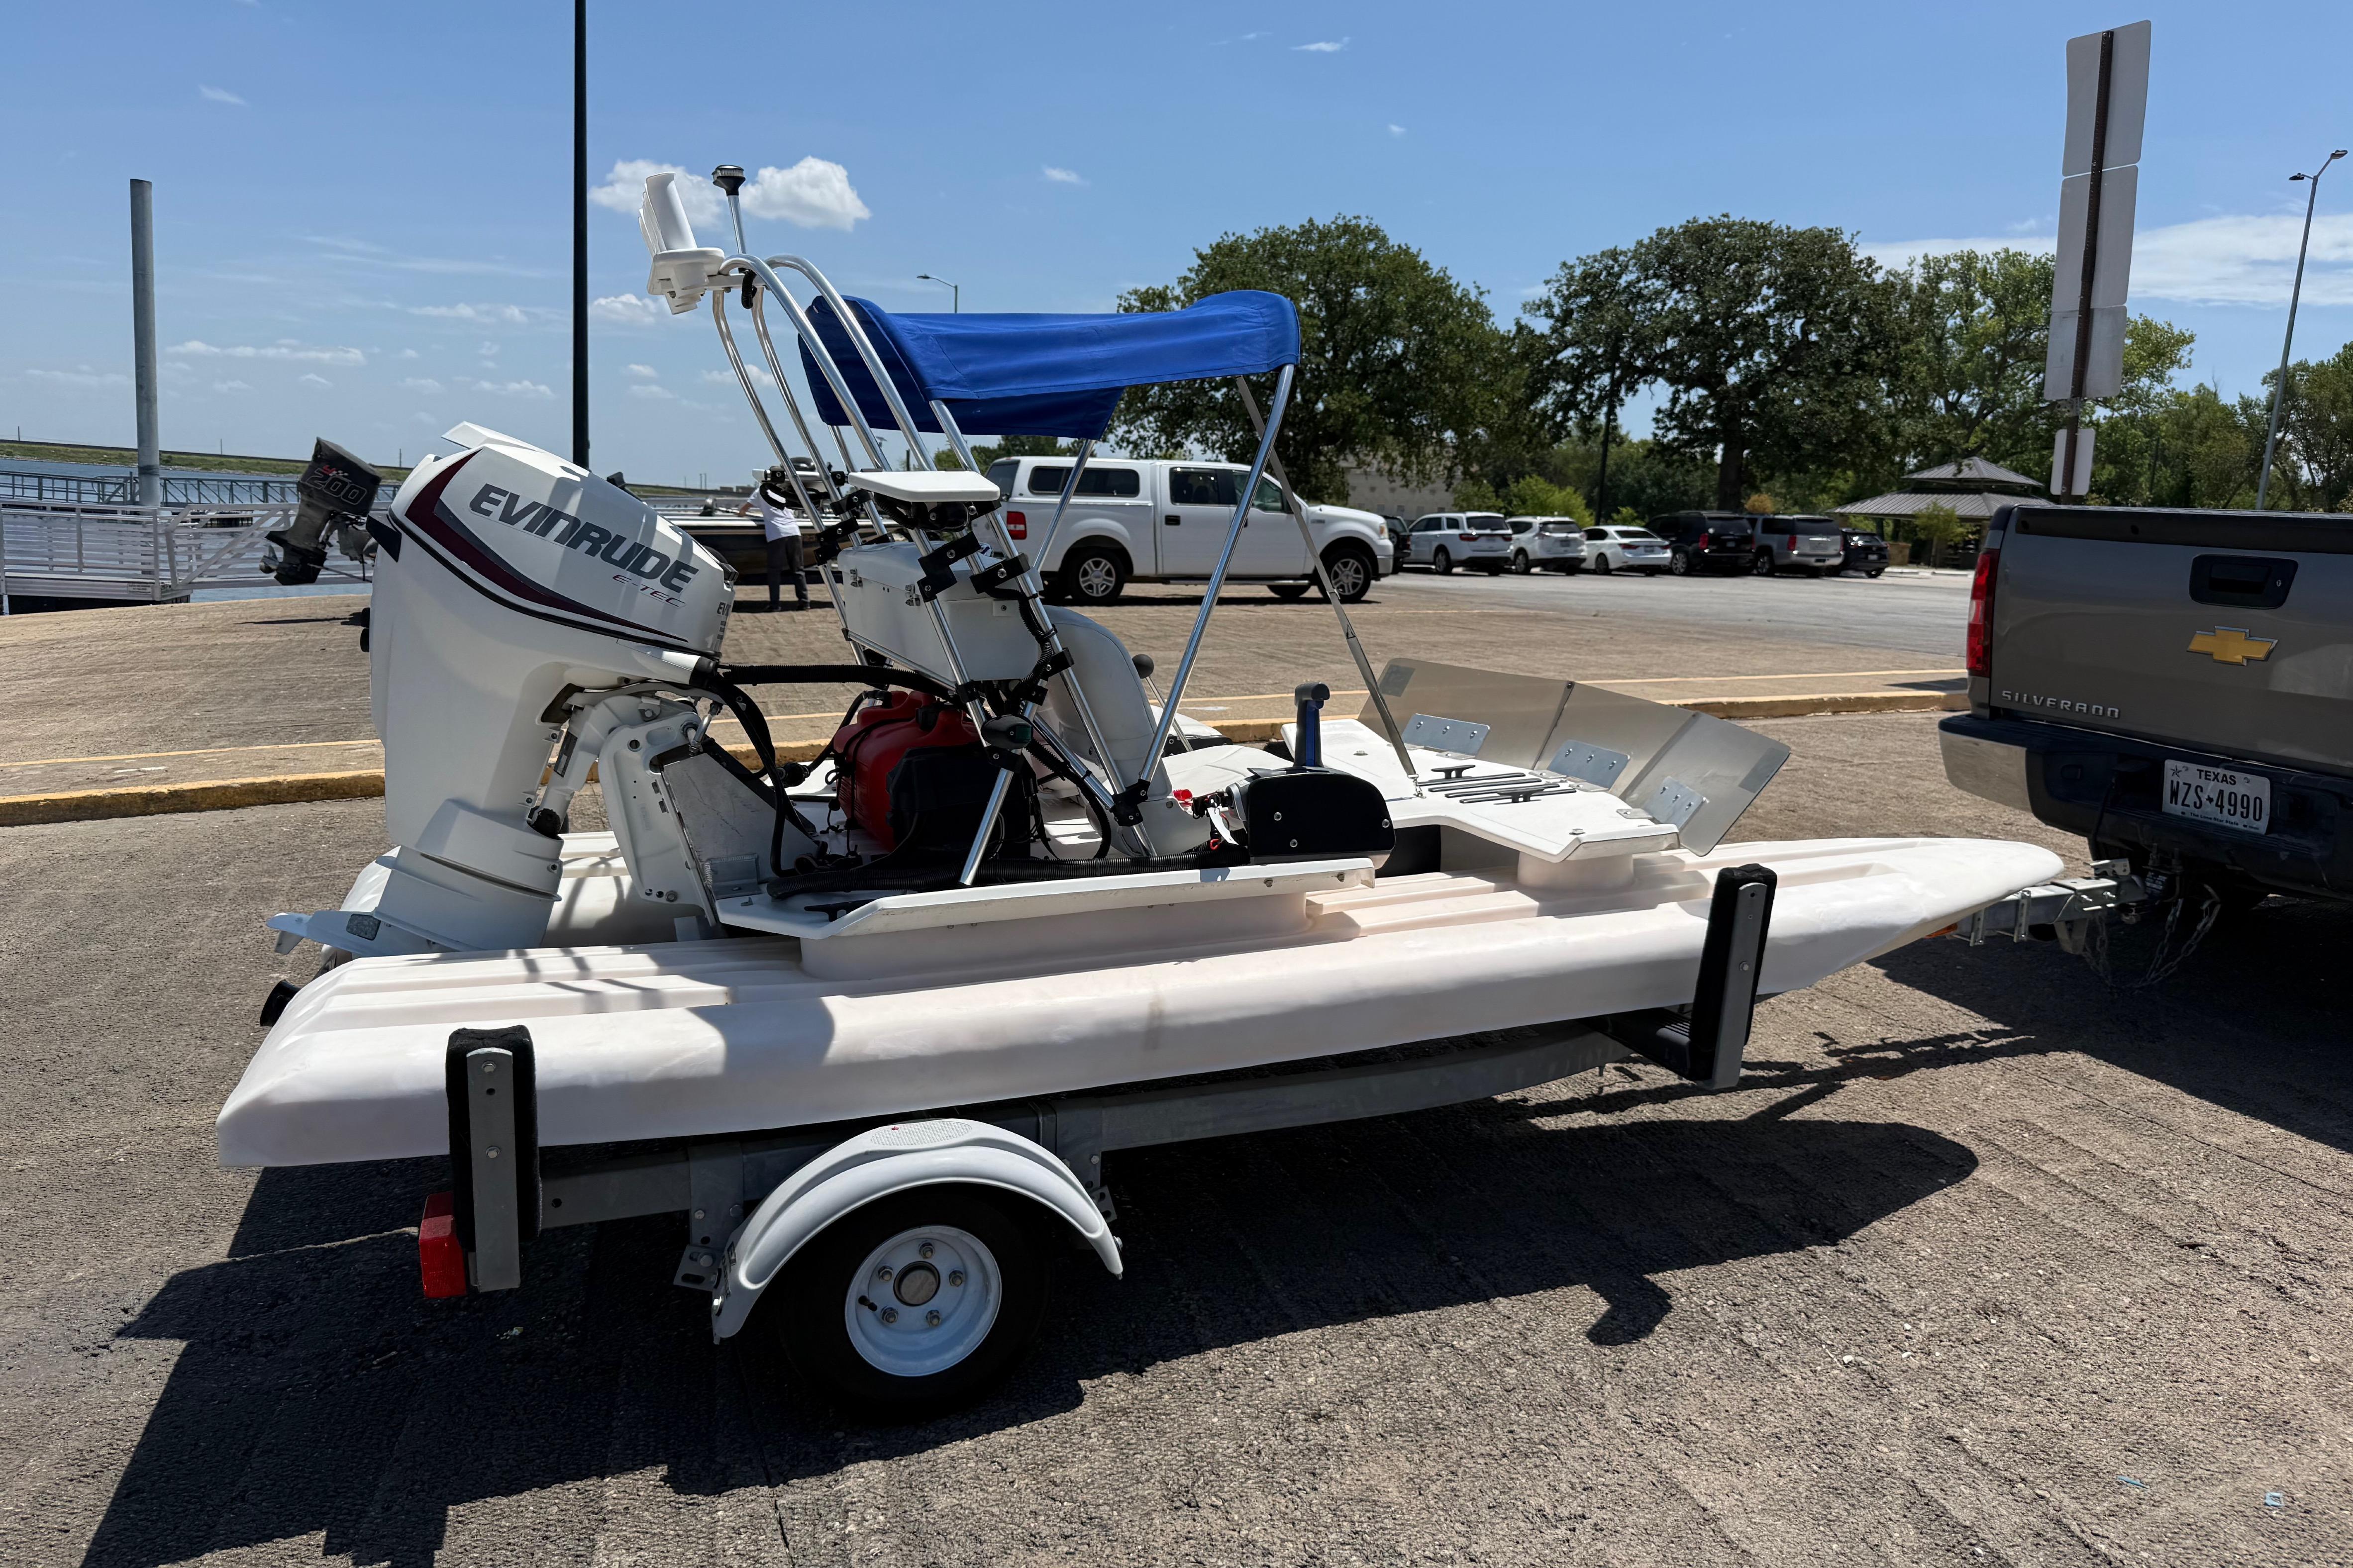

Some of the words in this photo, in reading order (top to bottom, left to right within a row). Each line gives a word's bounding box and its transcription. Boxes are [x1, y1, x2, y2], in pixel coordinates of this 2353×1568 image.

[300, 468, 367, 505] 200
[469, 483, 699, 593] EVINRUDE
[613, 574, 685, 607] E-TEC
[2002, 690, 2120, 718] SILVERADO
[2197, 769, 2237, 785] TEXAS
